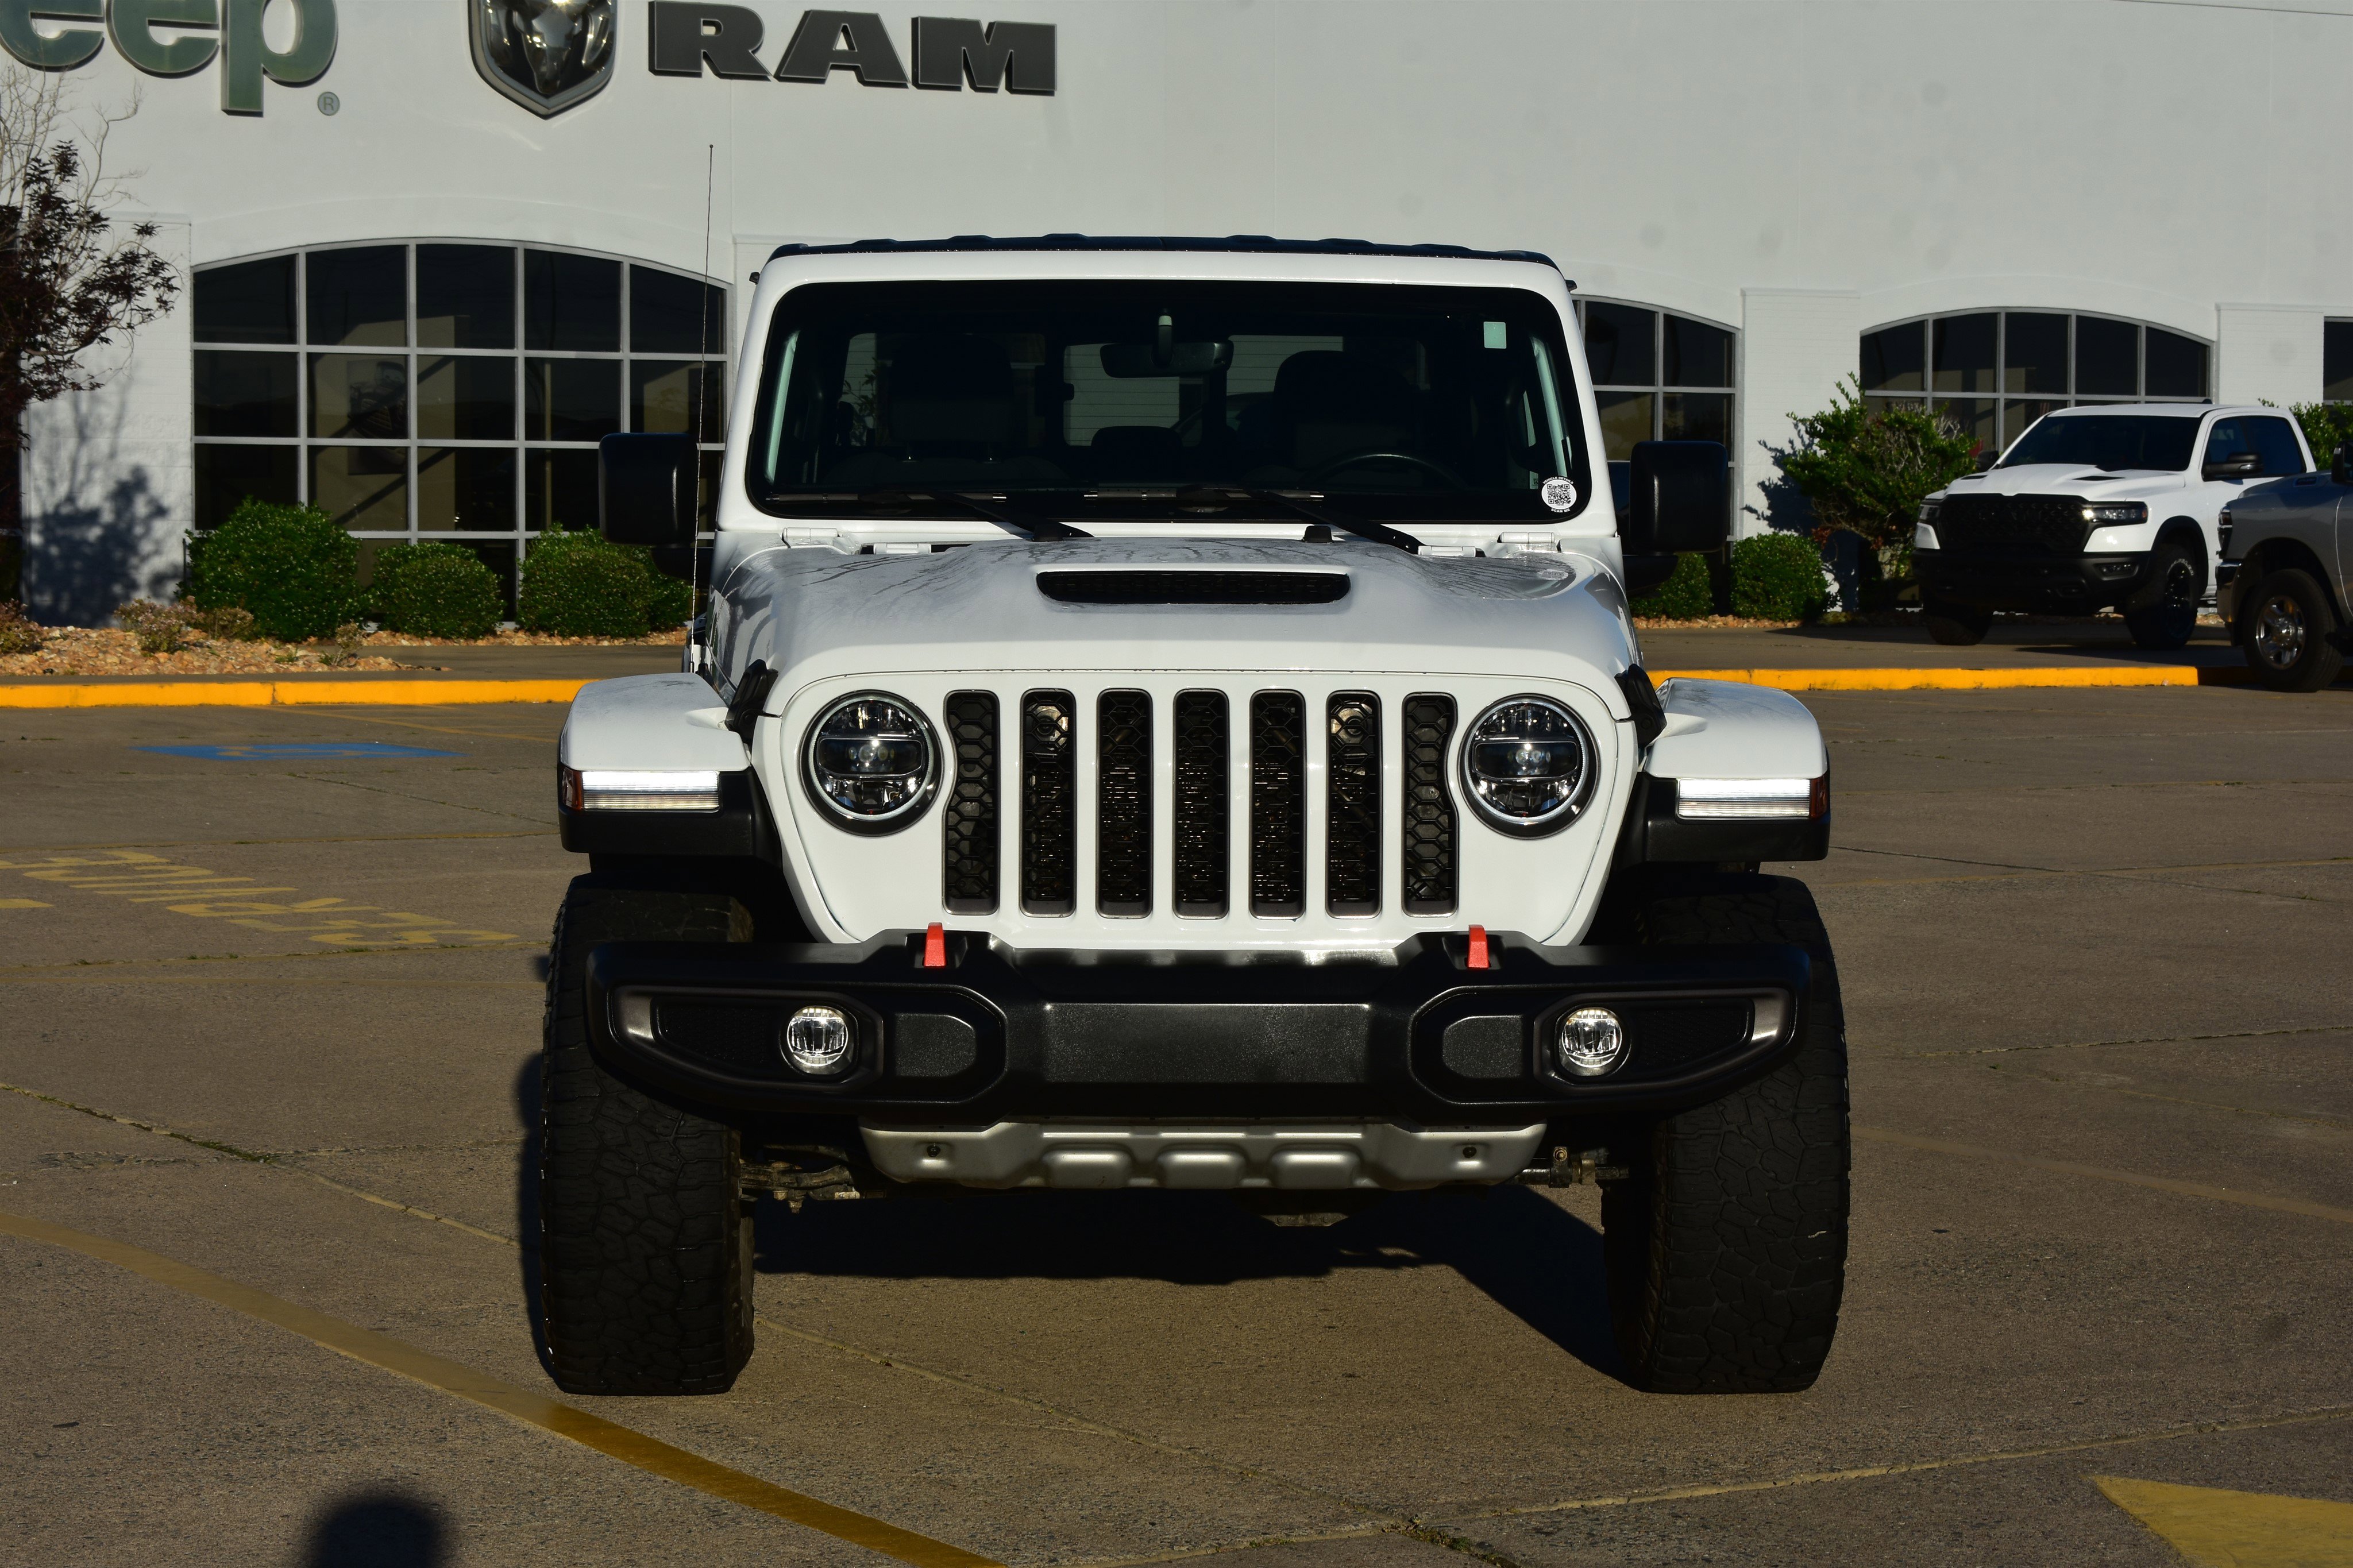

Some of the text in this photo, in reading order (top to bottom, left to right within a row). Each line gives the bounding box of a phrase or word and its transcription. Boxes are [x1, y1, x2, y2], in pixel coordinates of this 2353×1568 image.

[649, 1, 1057, 95] RAM
[1542, 476, 1574, 484] VEHICLE DETAILS
[0, 850, 519, 946] SERVICE
